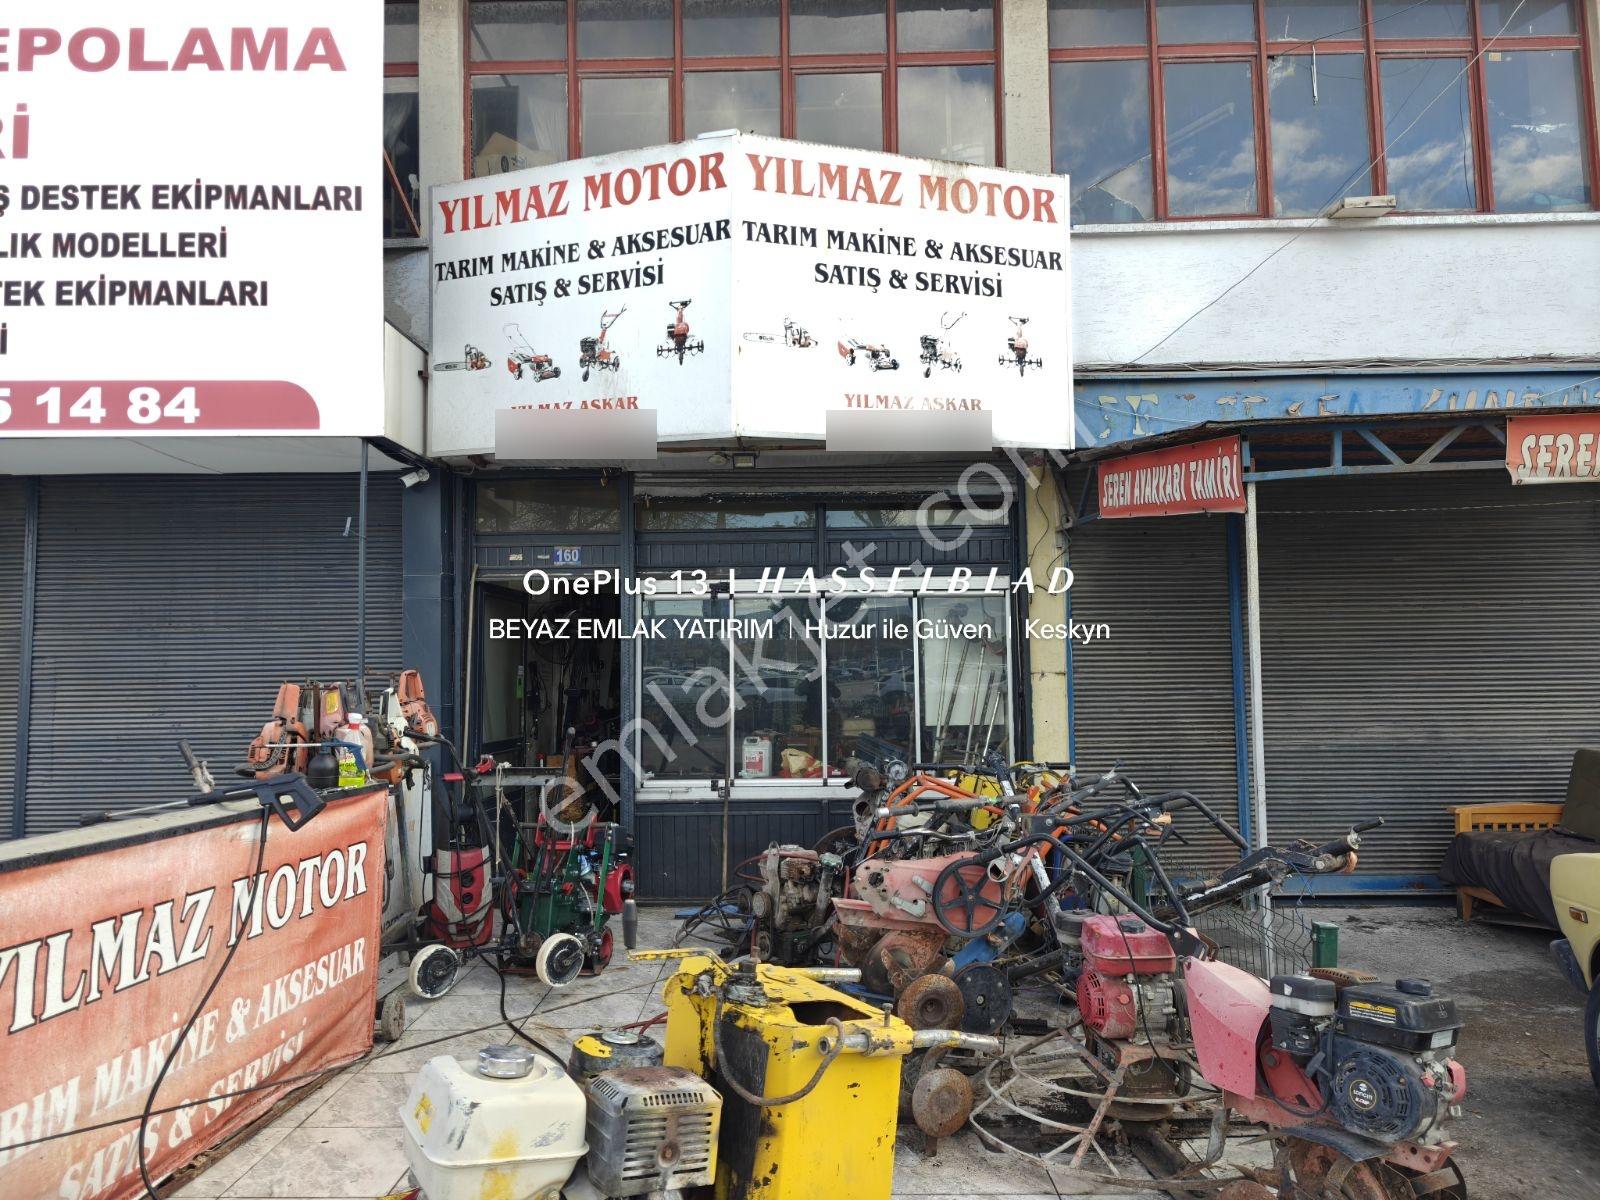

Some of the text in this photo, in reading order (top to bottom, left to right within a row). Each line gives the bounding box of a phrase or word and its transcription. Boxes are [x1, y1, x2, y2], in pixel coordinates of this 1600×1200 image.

[0, 27, 347, 72] POLAMA
[0, 103, 29, 159] İ
[21, 185, 142, 211] DESTEK
[151, 178, 362, 211] EKİPMANLARI
[438, 152, 727, 234] YILMAZ MOTOR
[745, 153, 1058, 223] YILMAZ MOTOR
[52, 226, 227, 258] MODELLERİ
[435, 219, 731, 282] TARIM MAKİNE & AKSESUAR
[742, 220, 1063, 271] TARIM MAKİNE & AKSESUAR
[0, 274, 268, 306] EK EKİPMANLARI
[490, 257, 664, 306] SATIŞ & SERVİSİ
[814, 263, 1003, 297] SATIŞ & SERVİSİ
[36, 386, 106, 424] 14
[126, 386, 200, 424] 84
[844, 393, 914, 409] YILMAZ
[1103, 443, 1240, 508] SEREN AYAKKABI TAMİRİ
[1517, 433, 1600, 478] SERE
[556, 549, 579, 561] 160
[226, 841, 368, 949] MOTOR
[92, 1008, 219, 1119] MAKİNE
[225, 996, 251, 1044] &
[253, 937, 365, 1031] AKSESUAR
[168, 1097, 201, 1149] &
[205, 1017, 307, 1127] SERVİSİ
